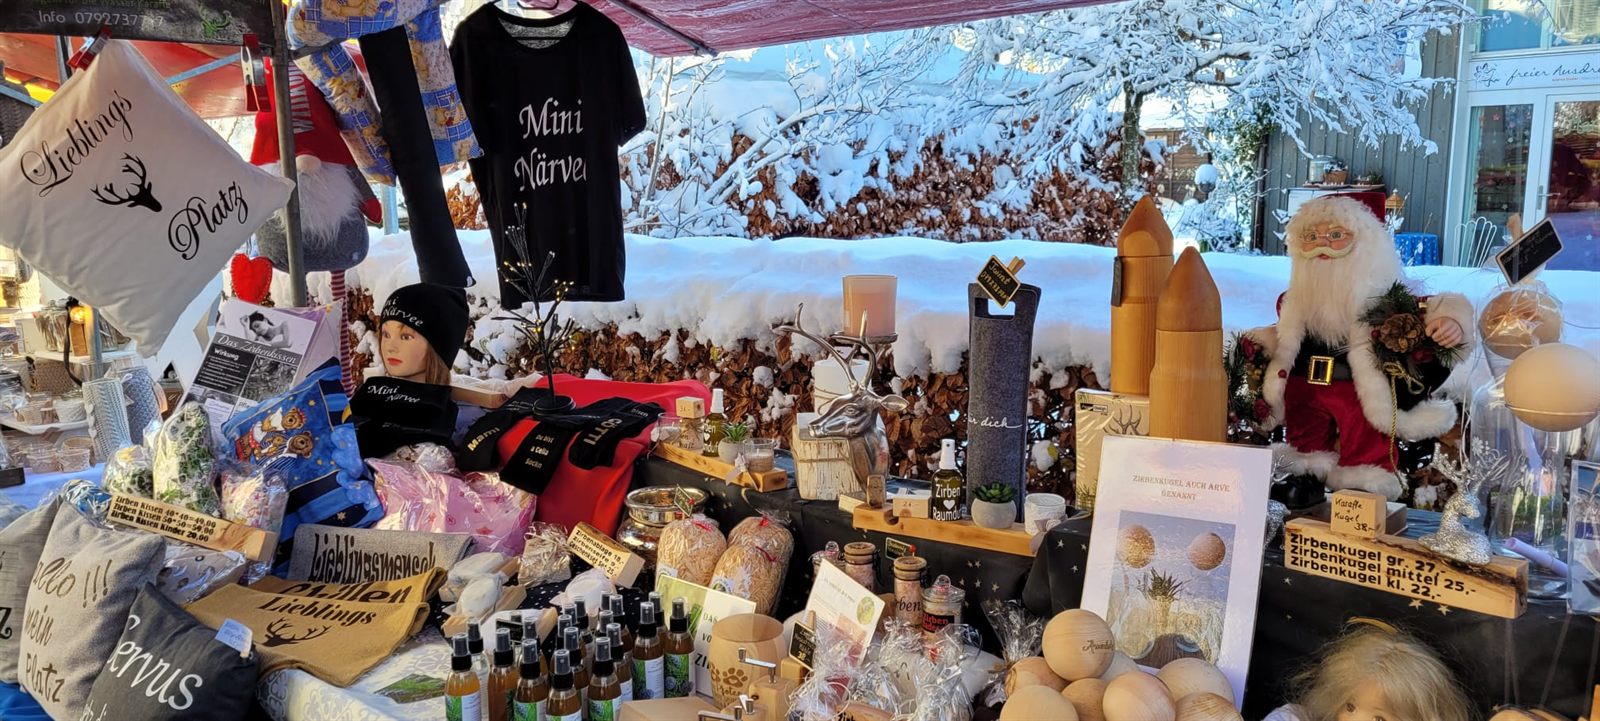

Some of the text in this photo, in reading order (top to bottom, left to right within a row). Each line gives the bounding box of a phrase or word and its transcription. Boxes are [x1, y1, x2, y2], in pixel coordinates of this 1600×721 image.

[39, 11, 65, 23] Info
[1505, 67, 1550, 86] freier
[519, 97, 584, 139] Mini
[20, 90, 134, 198] Lieblings
[168, 181, 248, 260] Platz
[214, 347, 240, 361] Wirkung
[217, 334, 297, 364] Das Zirbenkissen
[367, 385, 400, 395] Mini
[981, 416, 1023, 429] dich
[467, 427, 500, 451] Mami
[935, 483, 961, 499] Zirben
[1132, 474, 1230, 493] ZIRBENKUGEL AUCH ARVE
[1161, 490, 1197, 501] GENANNT
[113, 503, 137, 515] Zirben
[138, 509, 161, 521] Kissen
[116, 495, 139, 507] Zirben
[140, 501, 163, 514] Kissen
[111, 510, 134, 522] Zirben
[136, 516, 159, 528] Kissen
[160, 523, 186, 536] Kinder
[1334, 511, 1360, 523] Kugel
[576, 530, 612, 556] Zirbenablage
[1290, 533, 1446, 575] Zirbenkugel gr. 27,-
[1290, 545, 1476, 595] Zirbenkugel mittel 25,-
[1290, 556, 1441, 600] Zirbenkugel kl. 22,-
[258, 597, 377, 627] Lieblings
[25, 653, 65, 703] Platz
